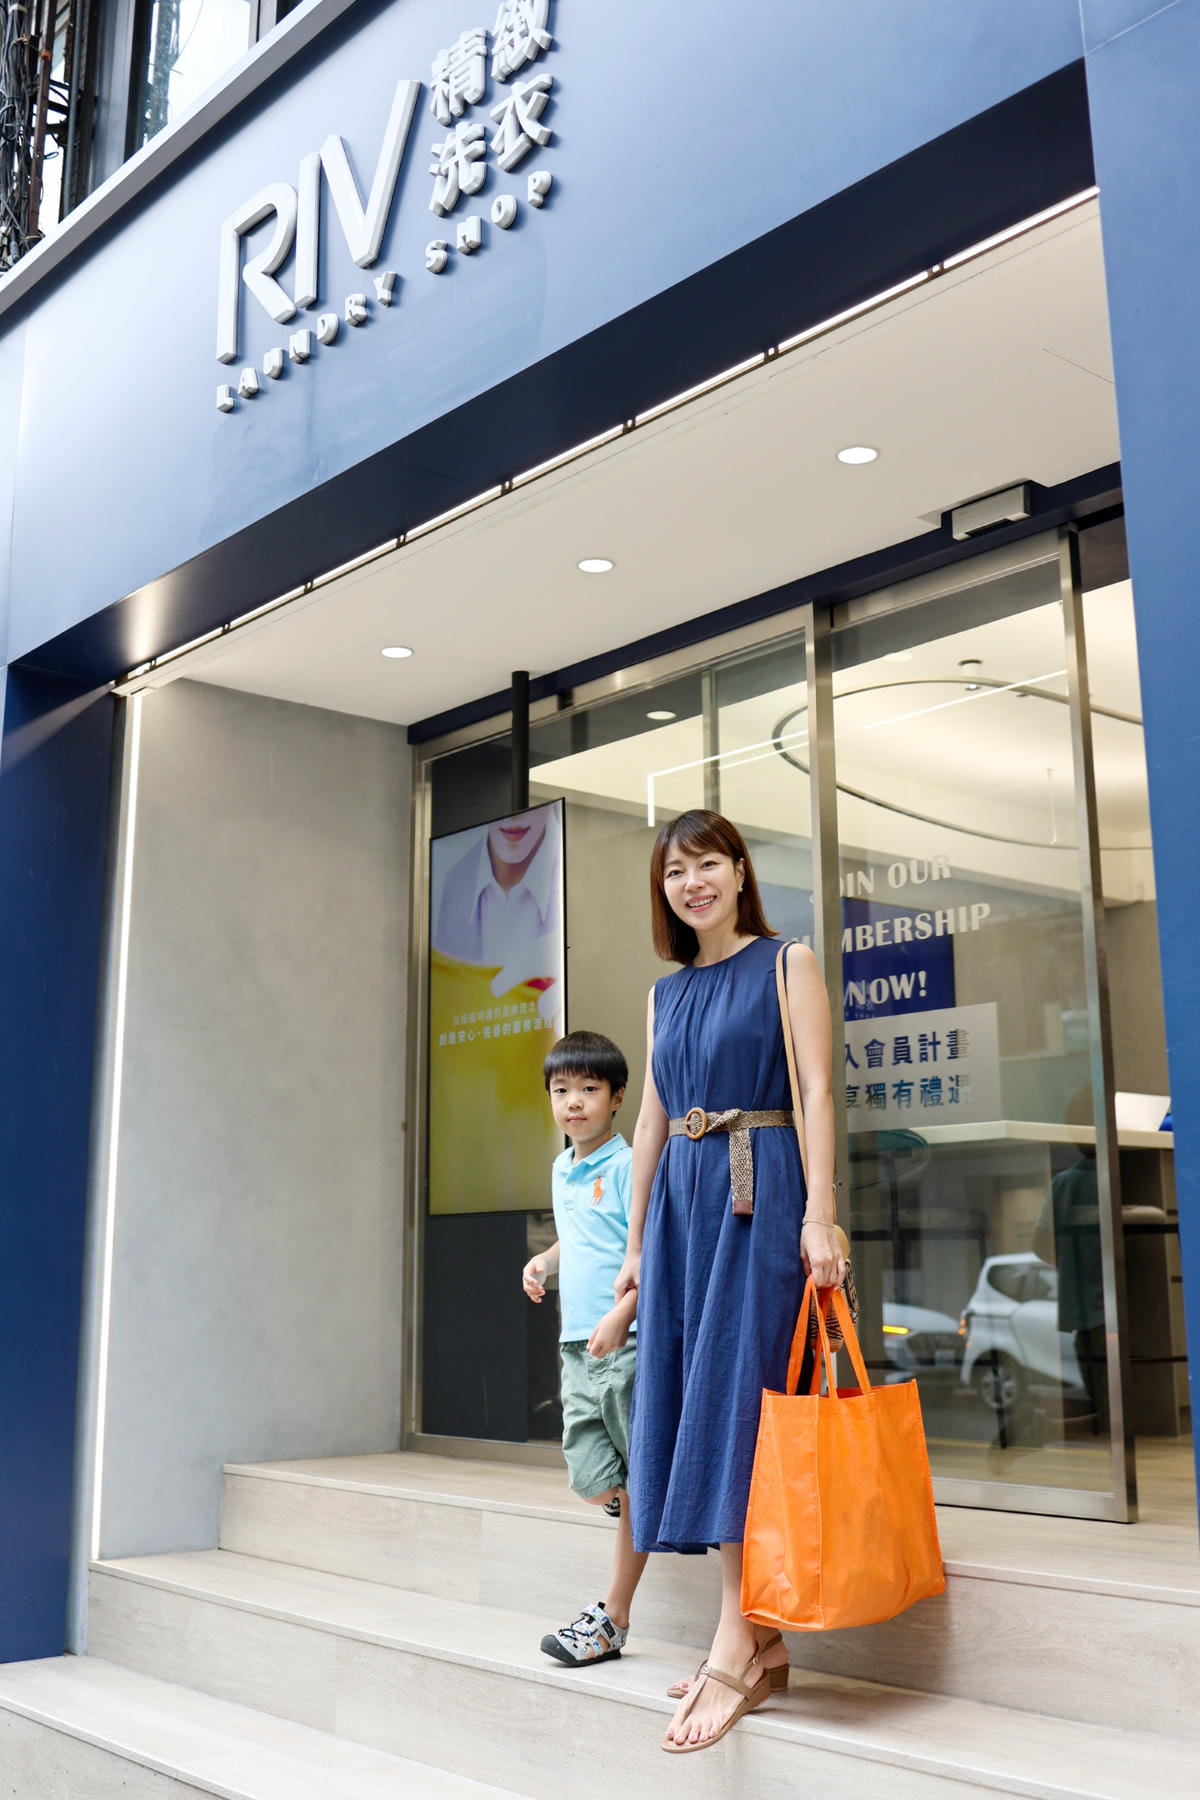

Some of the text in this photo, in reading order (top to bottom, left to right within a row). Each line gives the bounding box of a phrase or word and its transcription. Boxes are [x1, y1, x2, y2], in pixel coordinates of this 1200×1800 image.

[429, 73, 552, 217] 洗衣
[216, 170, 552, 412] LAUNDRY SHOP
[887, 854, 951, 889] OUR
[790, 902, 991, 953] BERSHIP
[848, 971, 927, 1007] NOW!
